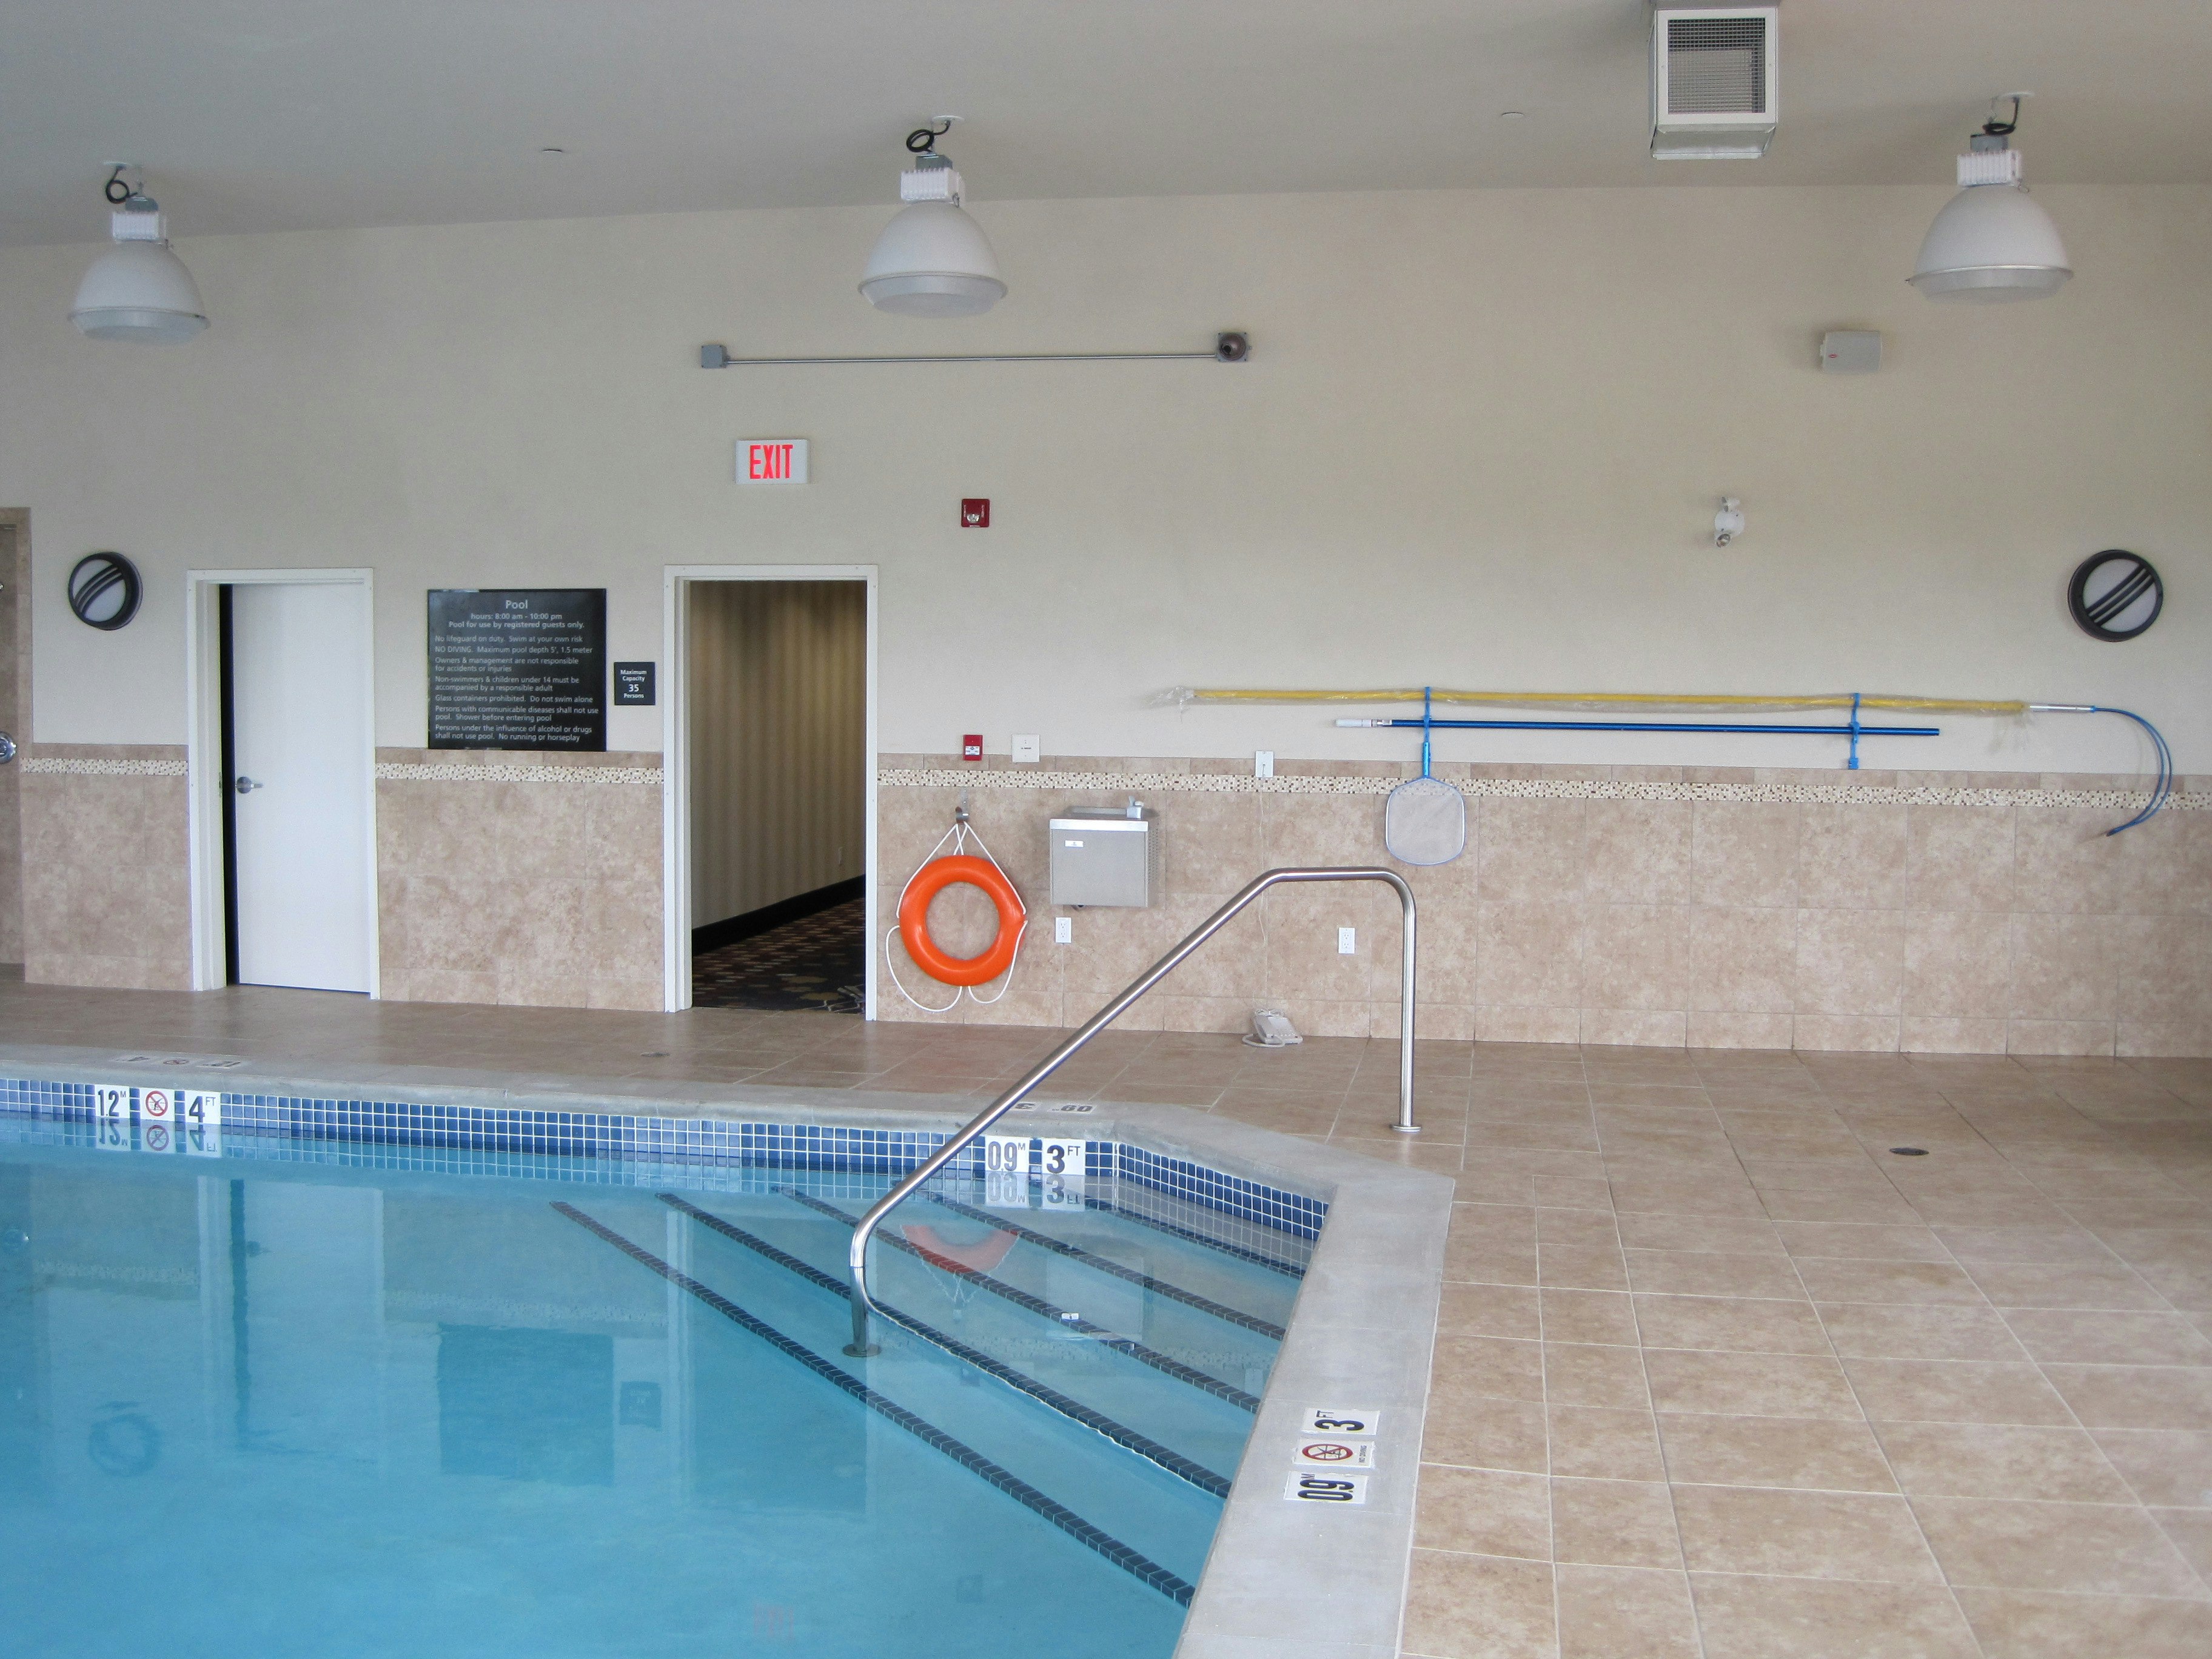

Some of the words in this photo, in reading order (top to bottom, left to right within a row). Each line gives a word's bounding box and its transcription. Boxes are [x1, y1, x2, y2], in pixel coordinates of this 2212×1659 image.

[749, 444, 793, 480] EXIT
[506, 600, 528, 609] Pool
[189, 1096, 205, 1123] 4
[206, 1096, 216, 1106] FT
[1047, 1145, 1065, 1174] 3
[1067, 1145, 1081, 1156] FT
[1315, 1419, 1364, 1430] 3
